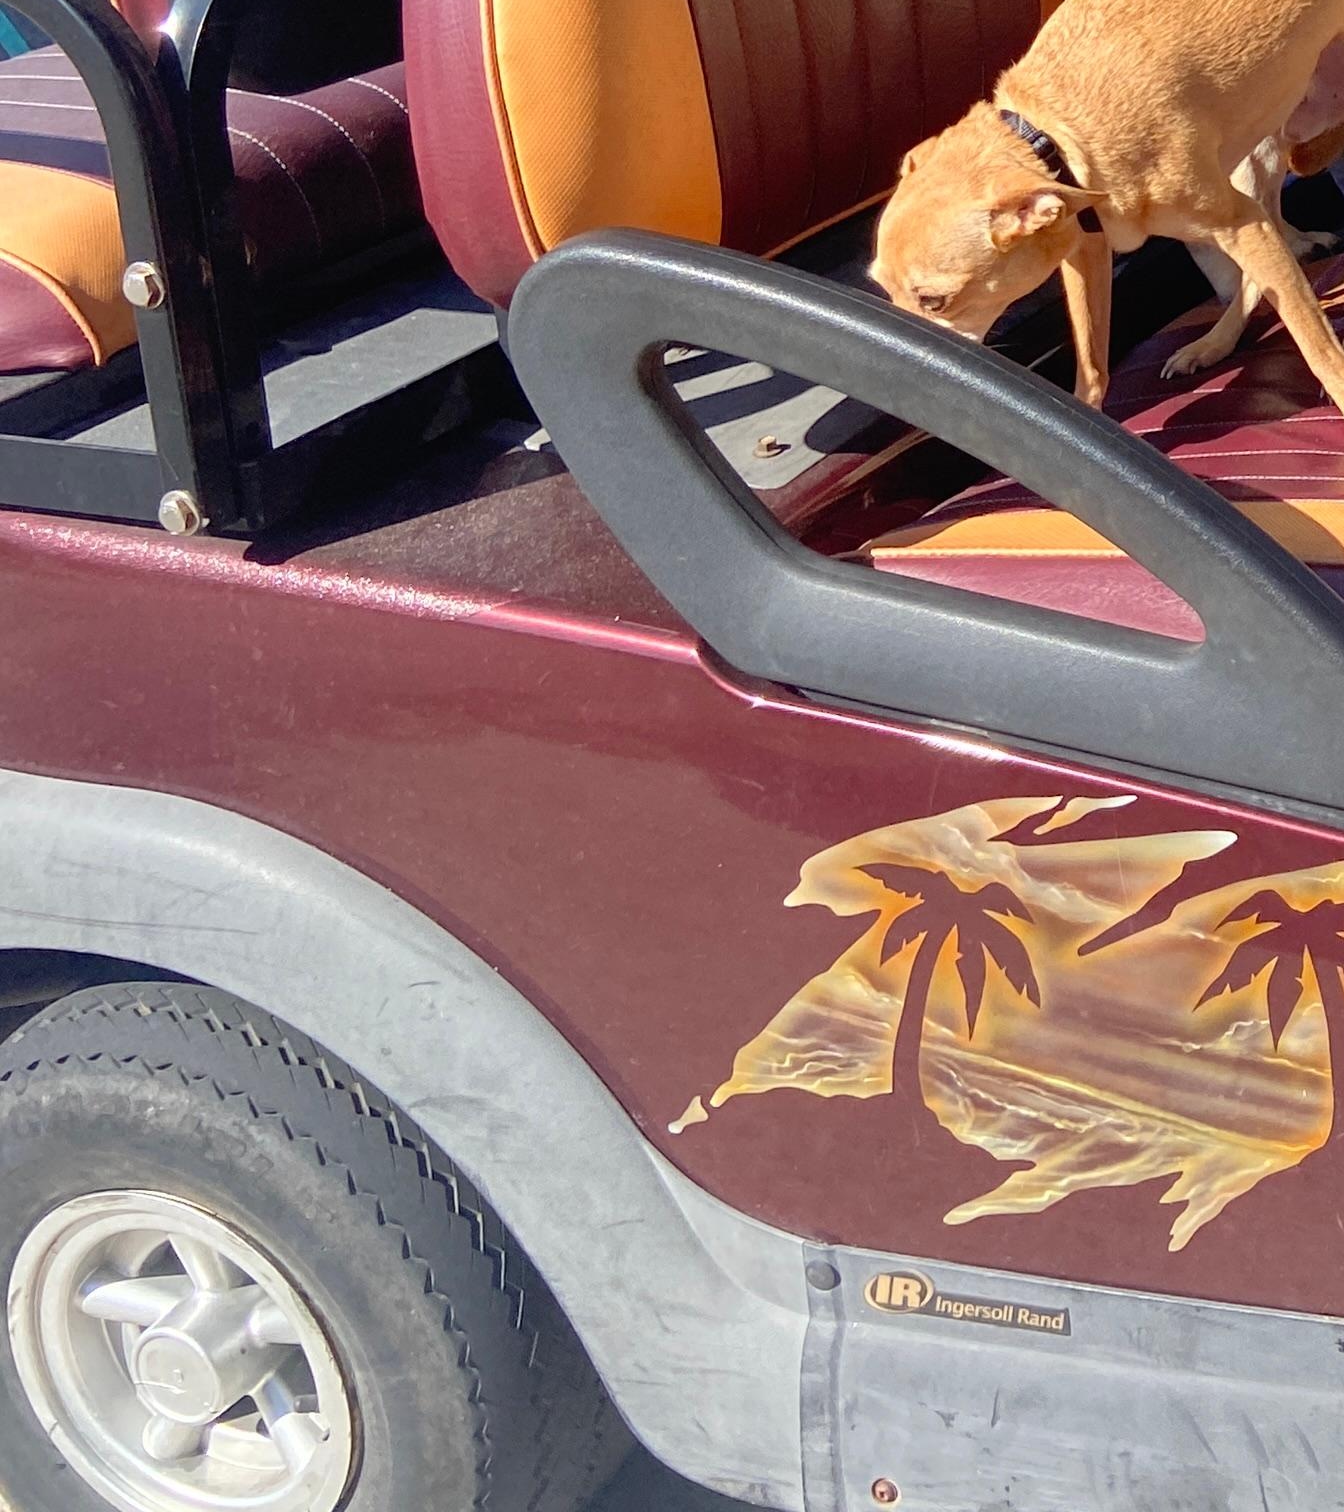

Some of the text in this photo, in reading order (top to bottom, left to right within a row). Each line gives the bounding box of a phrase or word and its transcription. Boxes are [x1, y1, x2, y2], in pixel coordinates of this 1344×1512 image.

[875, 1274, 922, 1308] IR
[935, 1296, 1065, 1331] Ingersoll Rand
